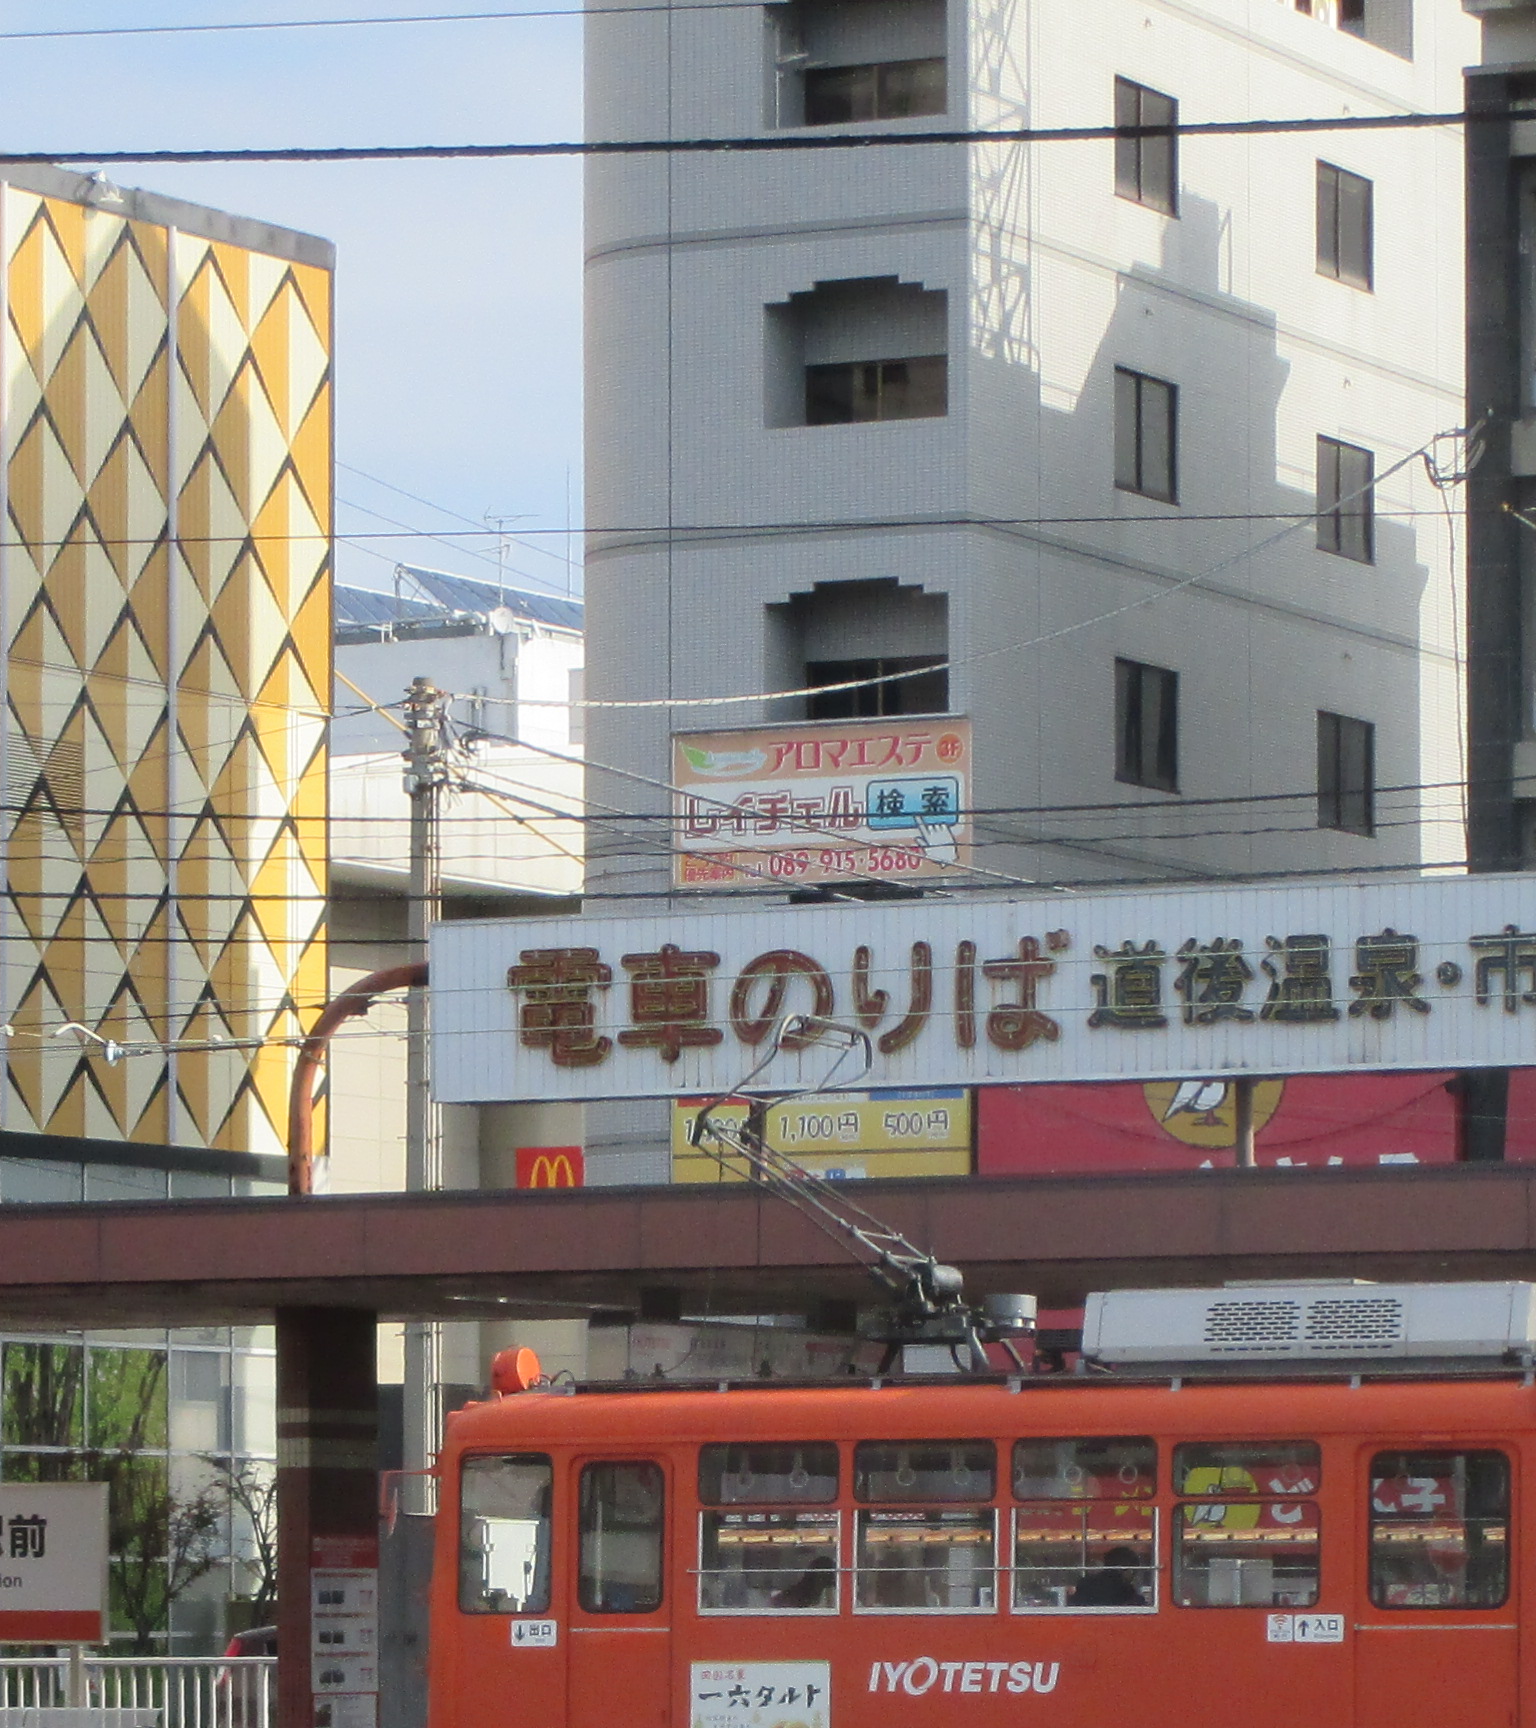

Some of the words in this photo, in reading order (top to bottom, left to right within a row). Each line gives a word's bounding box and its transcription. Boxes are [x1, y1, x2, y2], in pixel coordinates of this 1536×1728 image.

[768, 732, 932, 774] アロマエステ
[685, 786, 866, 838] レイチェル
[876, 786, 950, 816] 検索
[506, 928, 1070, 1068] 電車のりば
[883, 1108, 950, 1137] 500円
[529, 1623, 552, 1636] 出口
[1314, 1618, 1339, 1632] 入口
[868, 1656, 1061, 1696] IYOTETSU
[698, 1683, 822, 1709] 一六タルト
